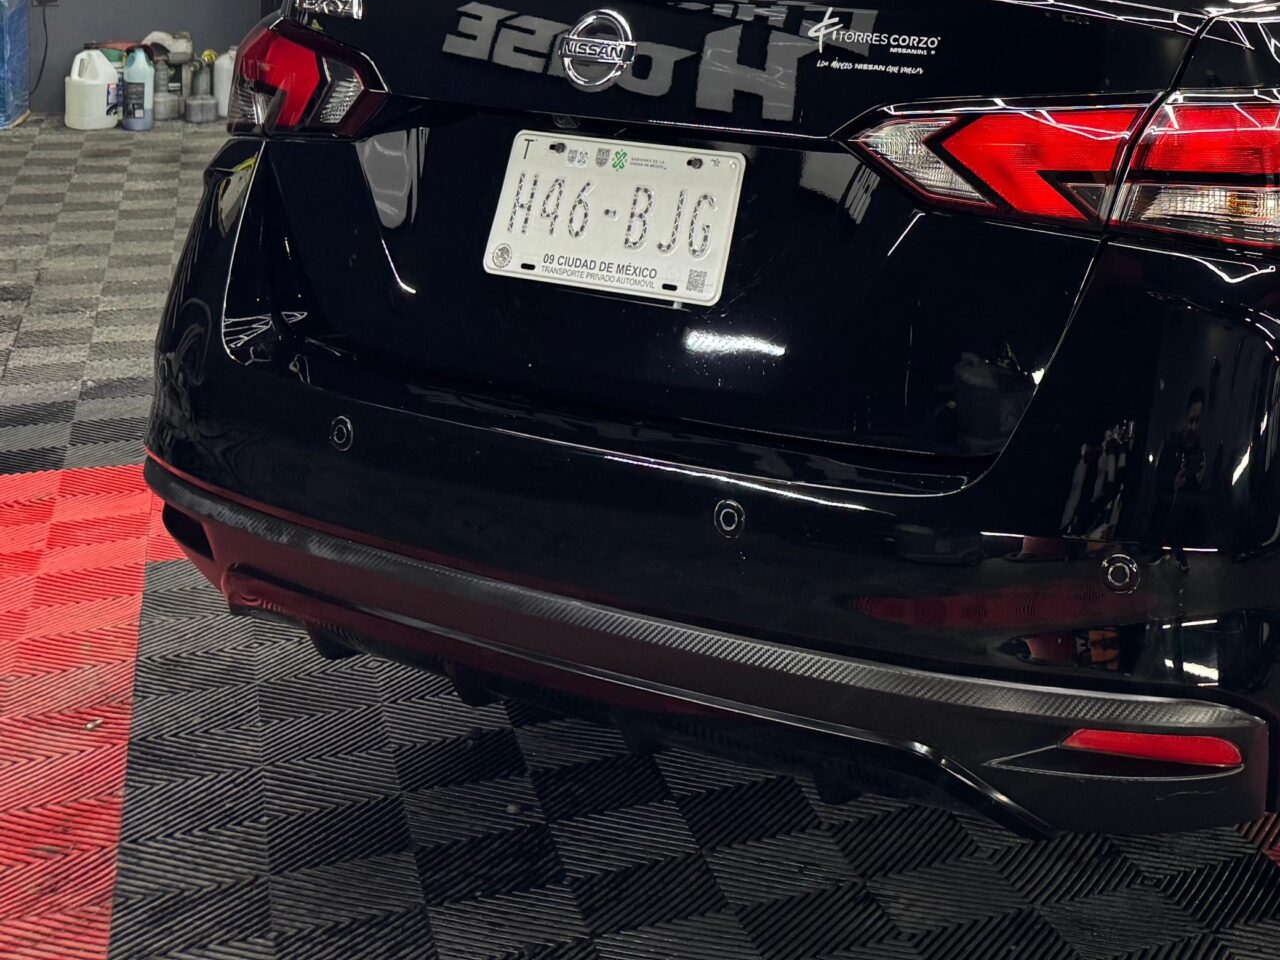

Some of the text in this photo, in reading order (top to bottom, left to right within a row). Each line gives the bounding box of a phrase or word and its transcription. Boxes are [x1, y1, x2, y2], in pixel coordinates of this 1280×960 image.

[561, 40, 625, 60] NISSAN
[838, 30, 939, 49] TORRES CORZO
[854, 63, 886, 72] NISSAN
[507, 172, 719, 259] H46-BJG
[541, 265, 655, 289] TRANSPORTE PRIVADO AUTOMÓVIL
[543, 253, 658, 279] 09 CIUDAD DE MÉXICO
